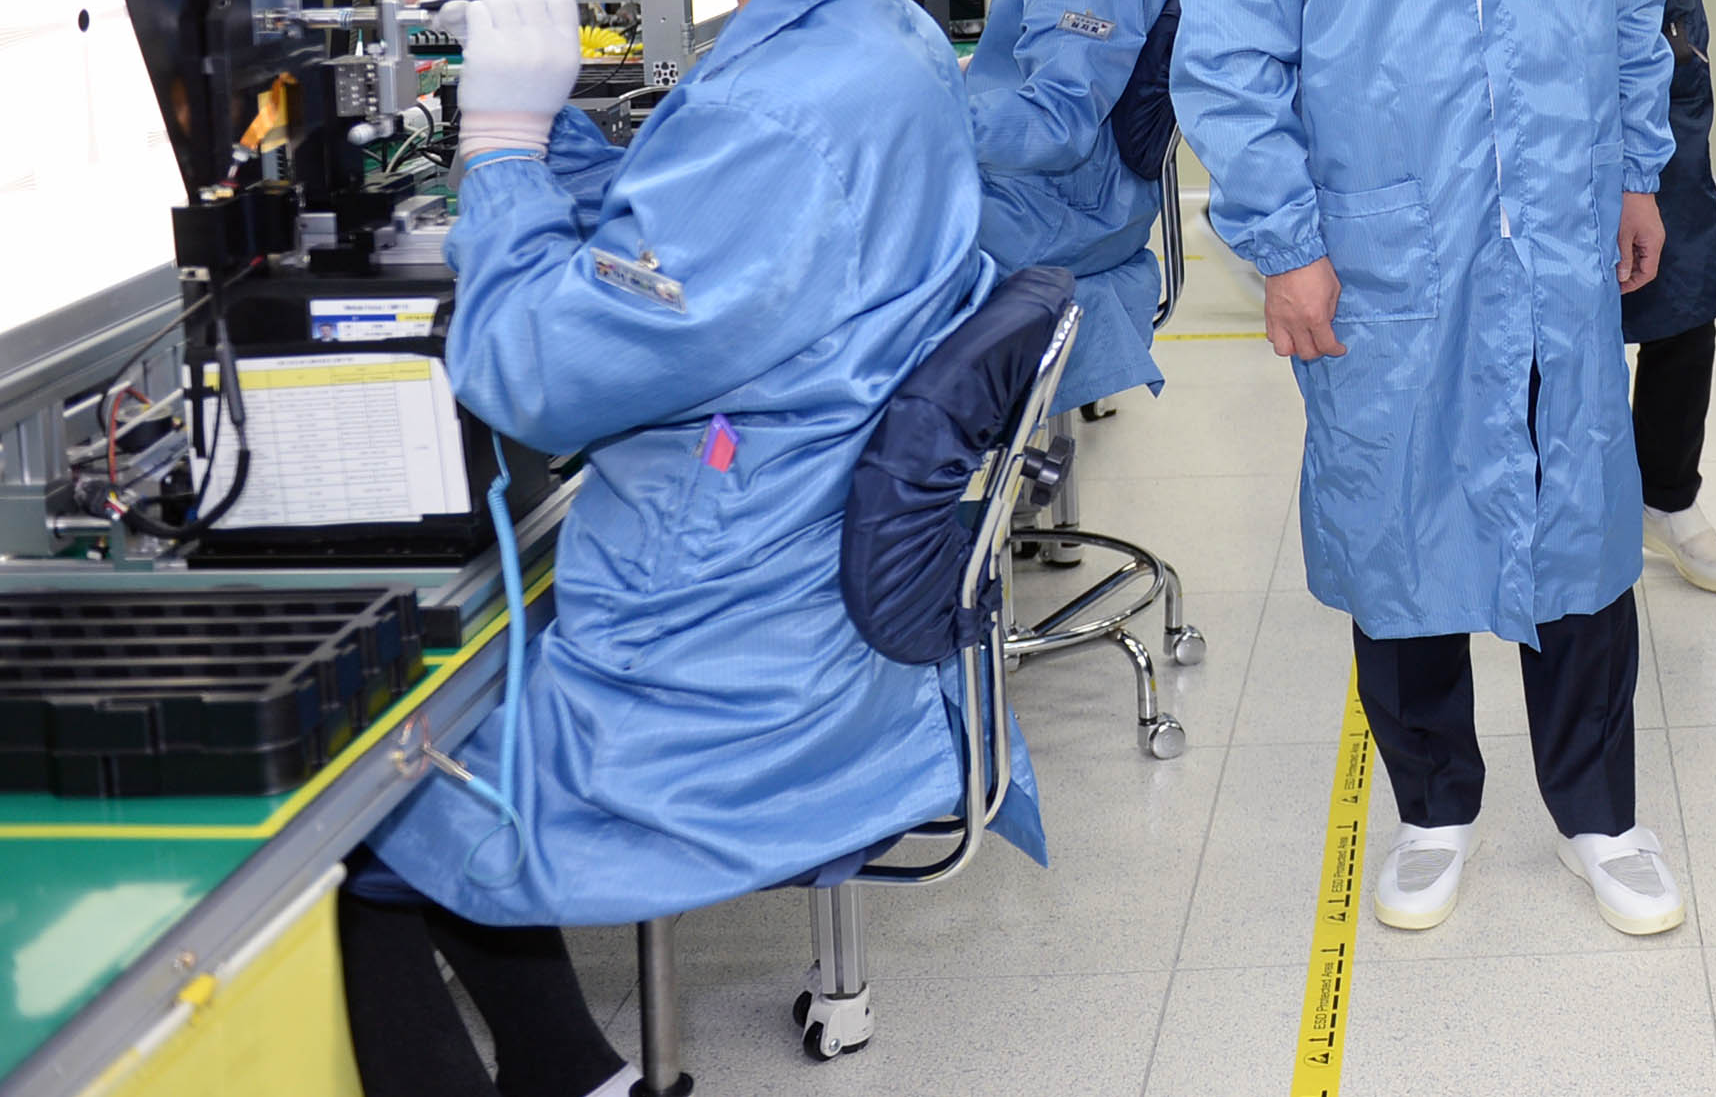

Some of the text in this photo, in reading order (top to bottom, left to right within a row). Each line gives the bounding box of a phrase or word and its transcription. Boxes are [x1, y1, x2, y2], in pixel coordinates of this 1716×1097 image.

[1331, 837, 1348, 893] ESD Protected Area
[1313, 962, 1334, 1029] ESD Protected Area
